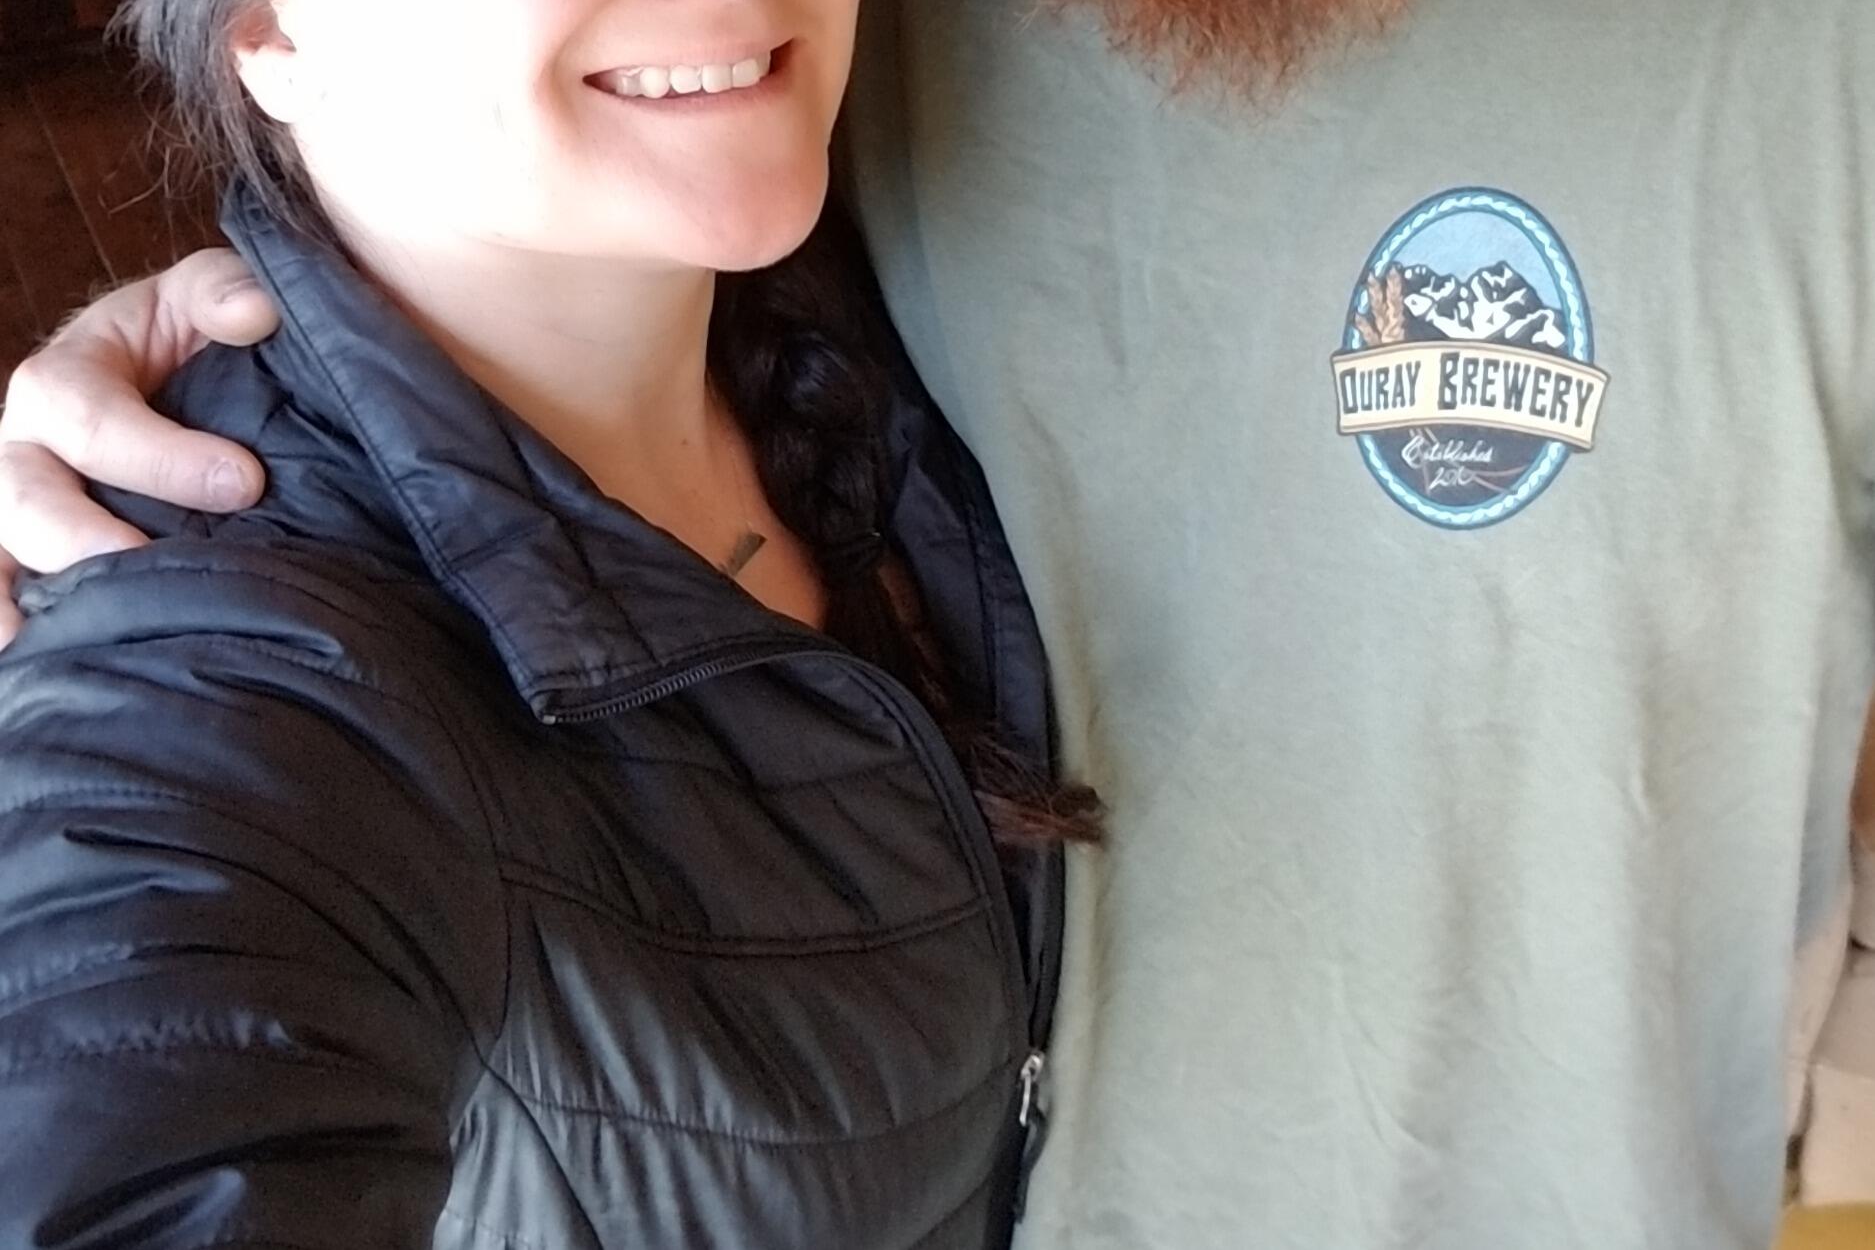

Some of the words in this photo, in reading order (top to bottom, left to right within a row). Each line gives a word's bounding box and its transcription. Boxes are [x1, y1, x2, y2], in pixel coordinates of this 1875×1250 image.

[1339, 361, 1421, 414] OURAY
[1438, 352, 1594, 427] BREWERY
[1401, 435, 1494, 469] Established
